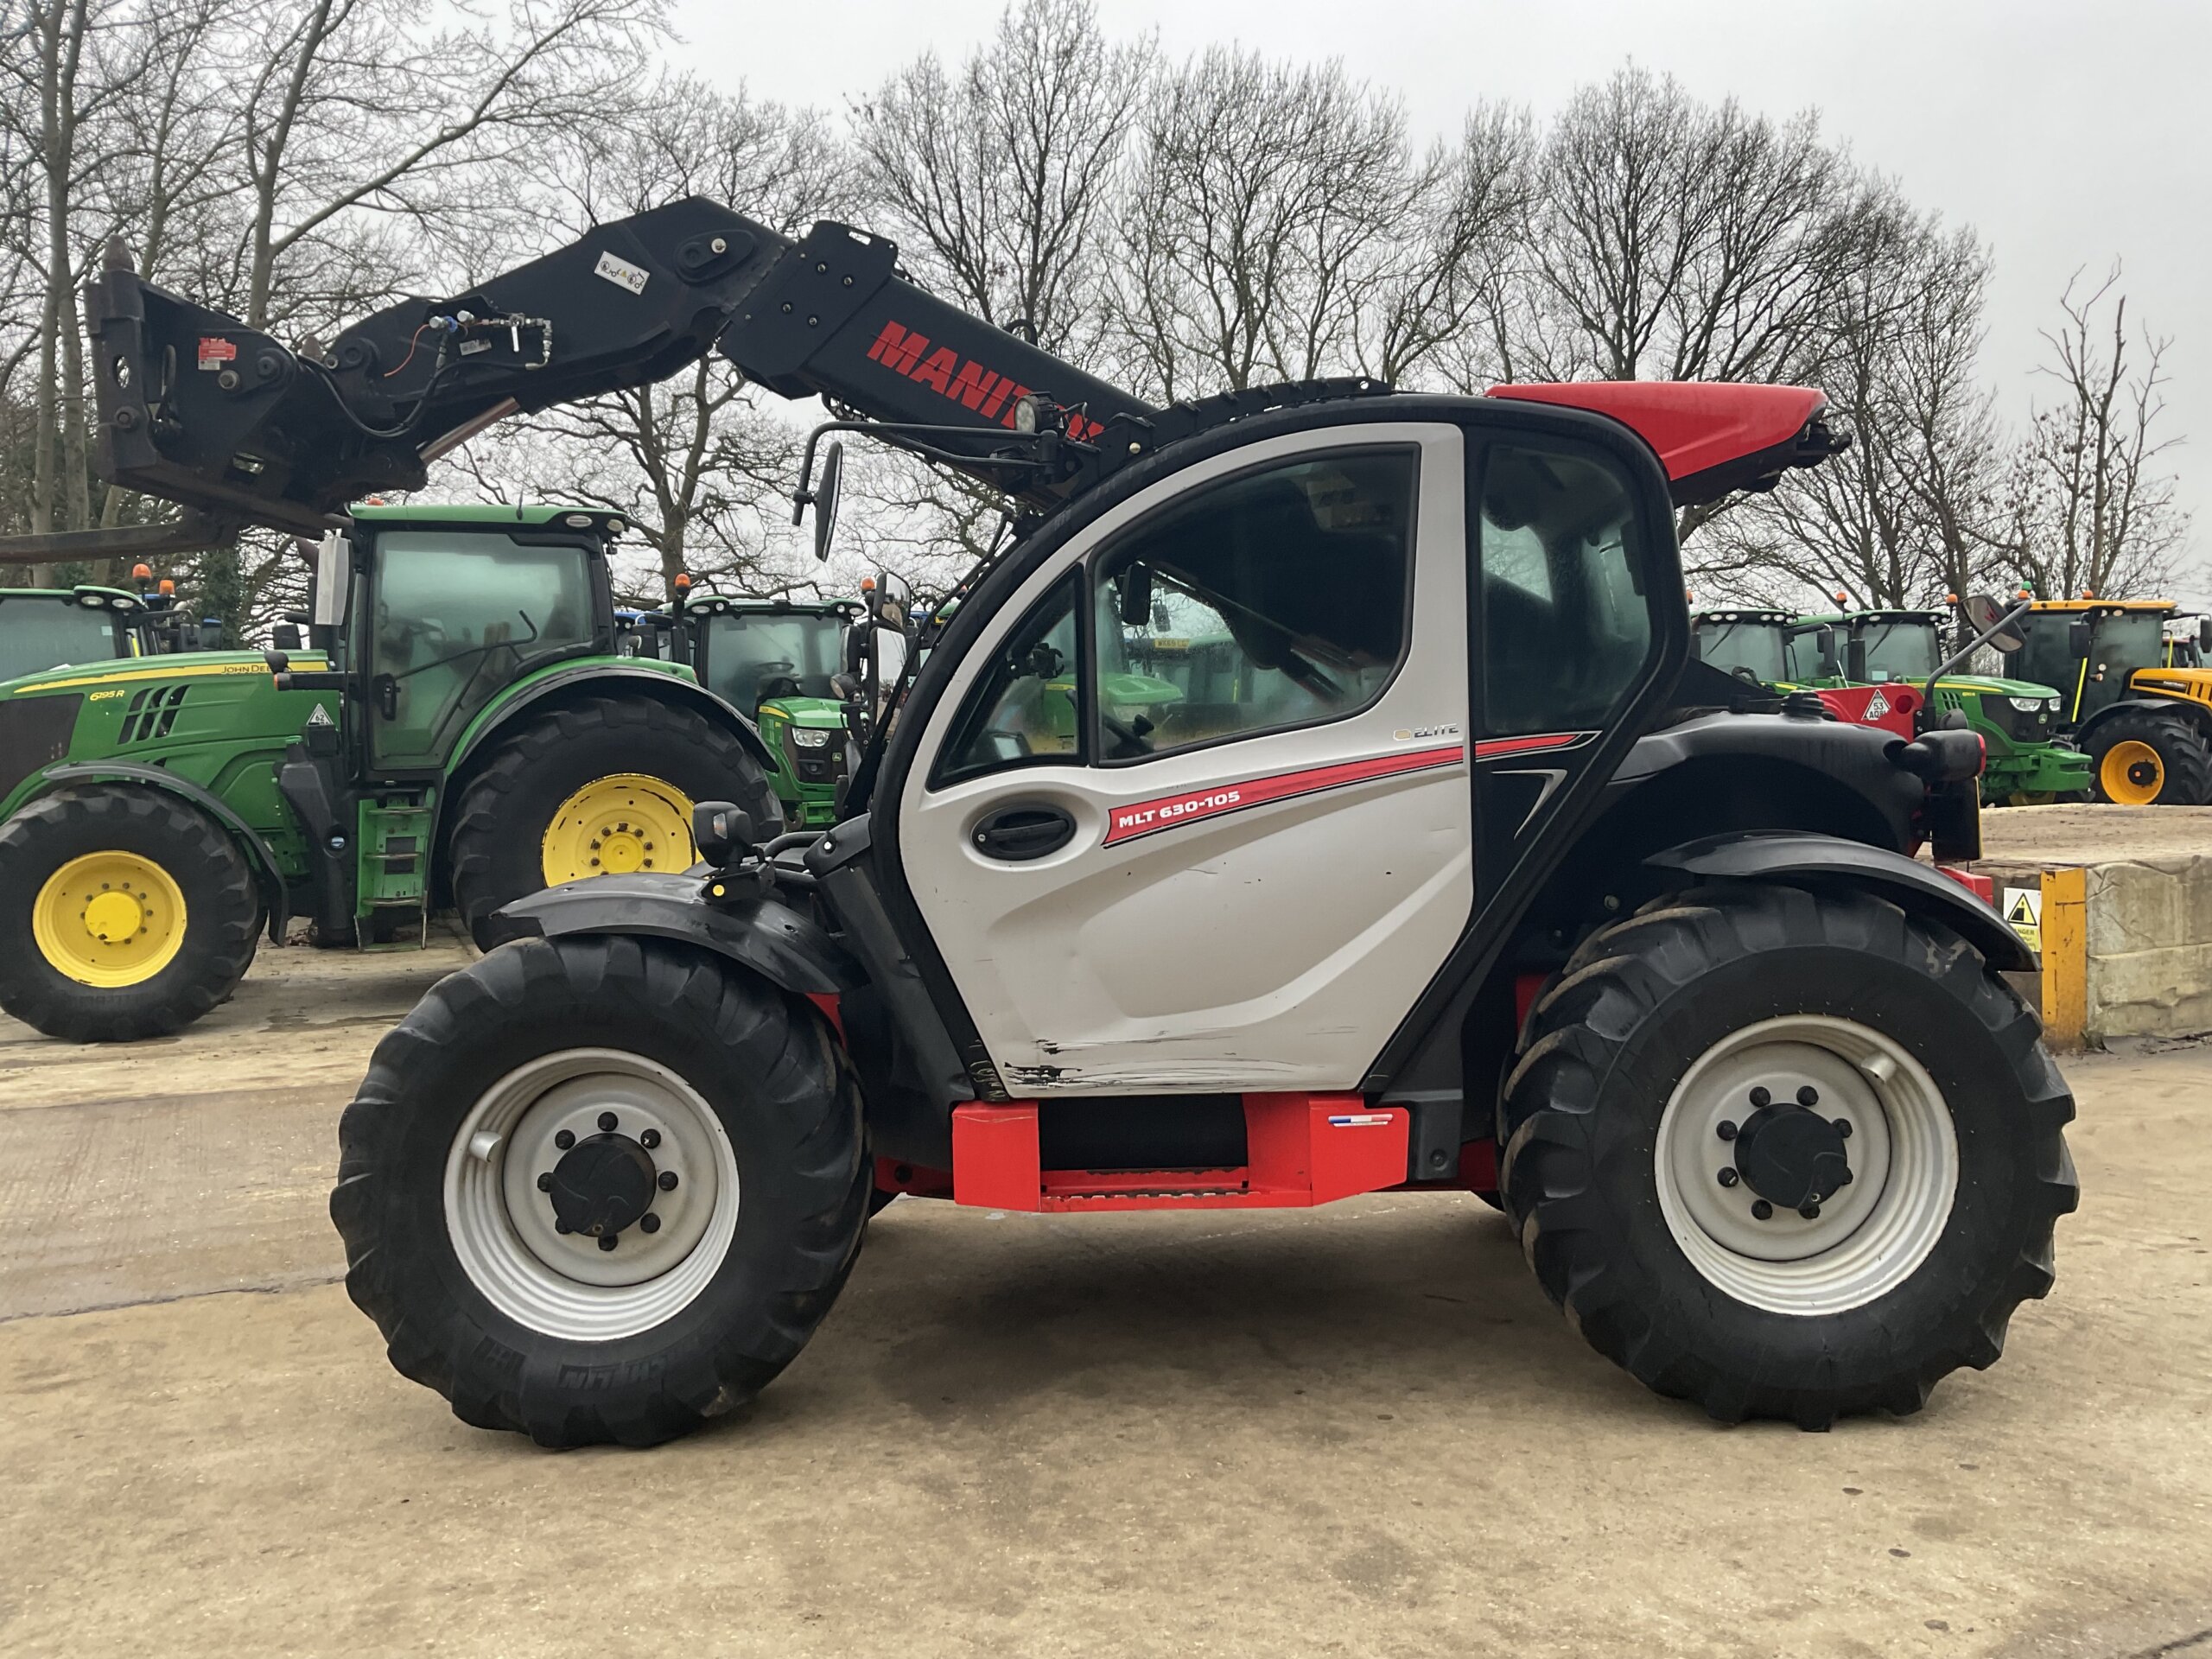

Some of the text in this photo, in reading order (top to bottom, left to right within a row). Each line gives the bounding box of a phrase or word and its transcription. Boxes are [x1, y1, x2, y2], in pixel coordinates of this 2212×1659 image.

[1873, 702, 1885, 710] 53
[1414, 723, 1459, 738] ELITE
[1119, 791, 1240, 829] MLT 630-105
